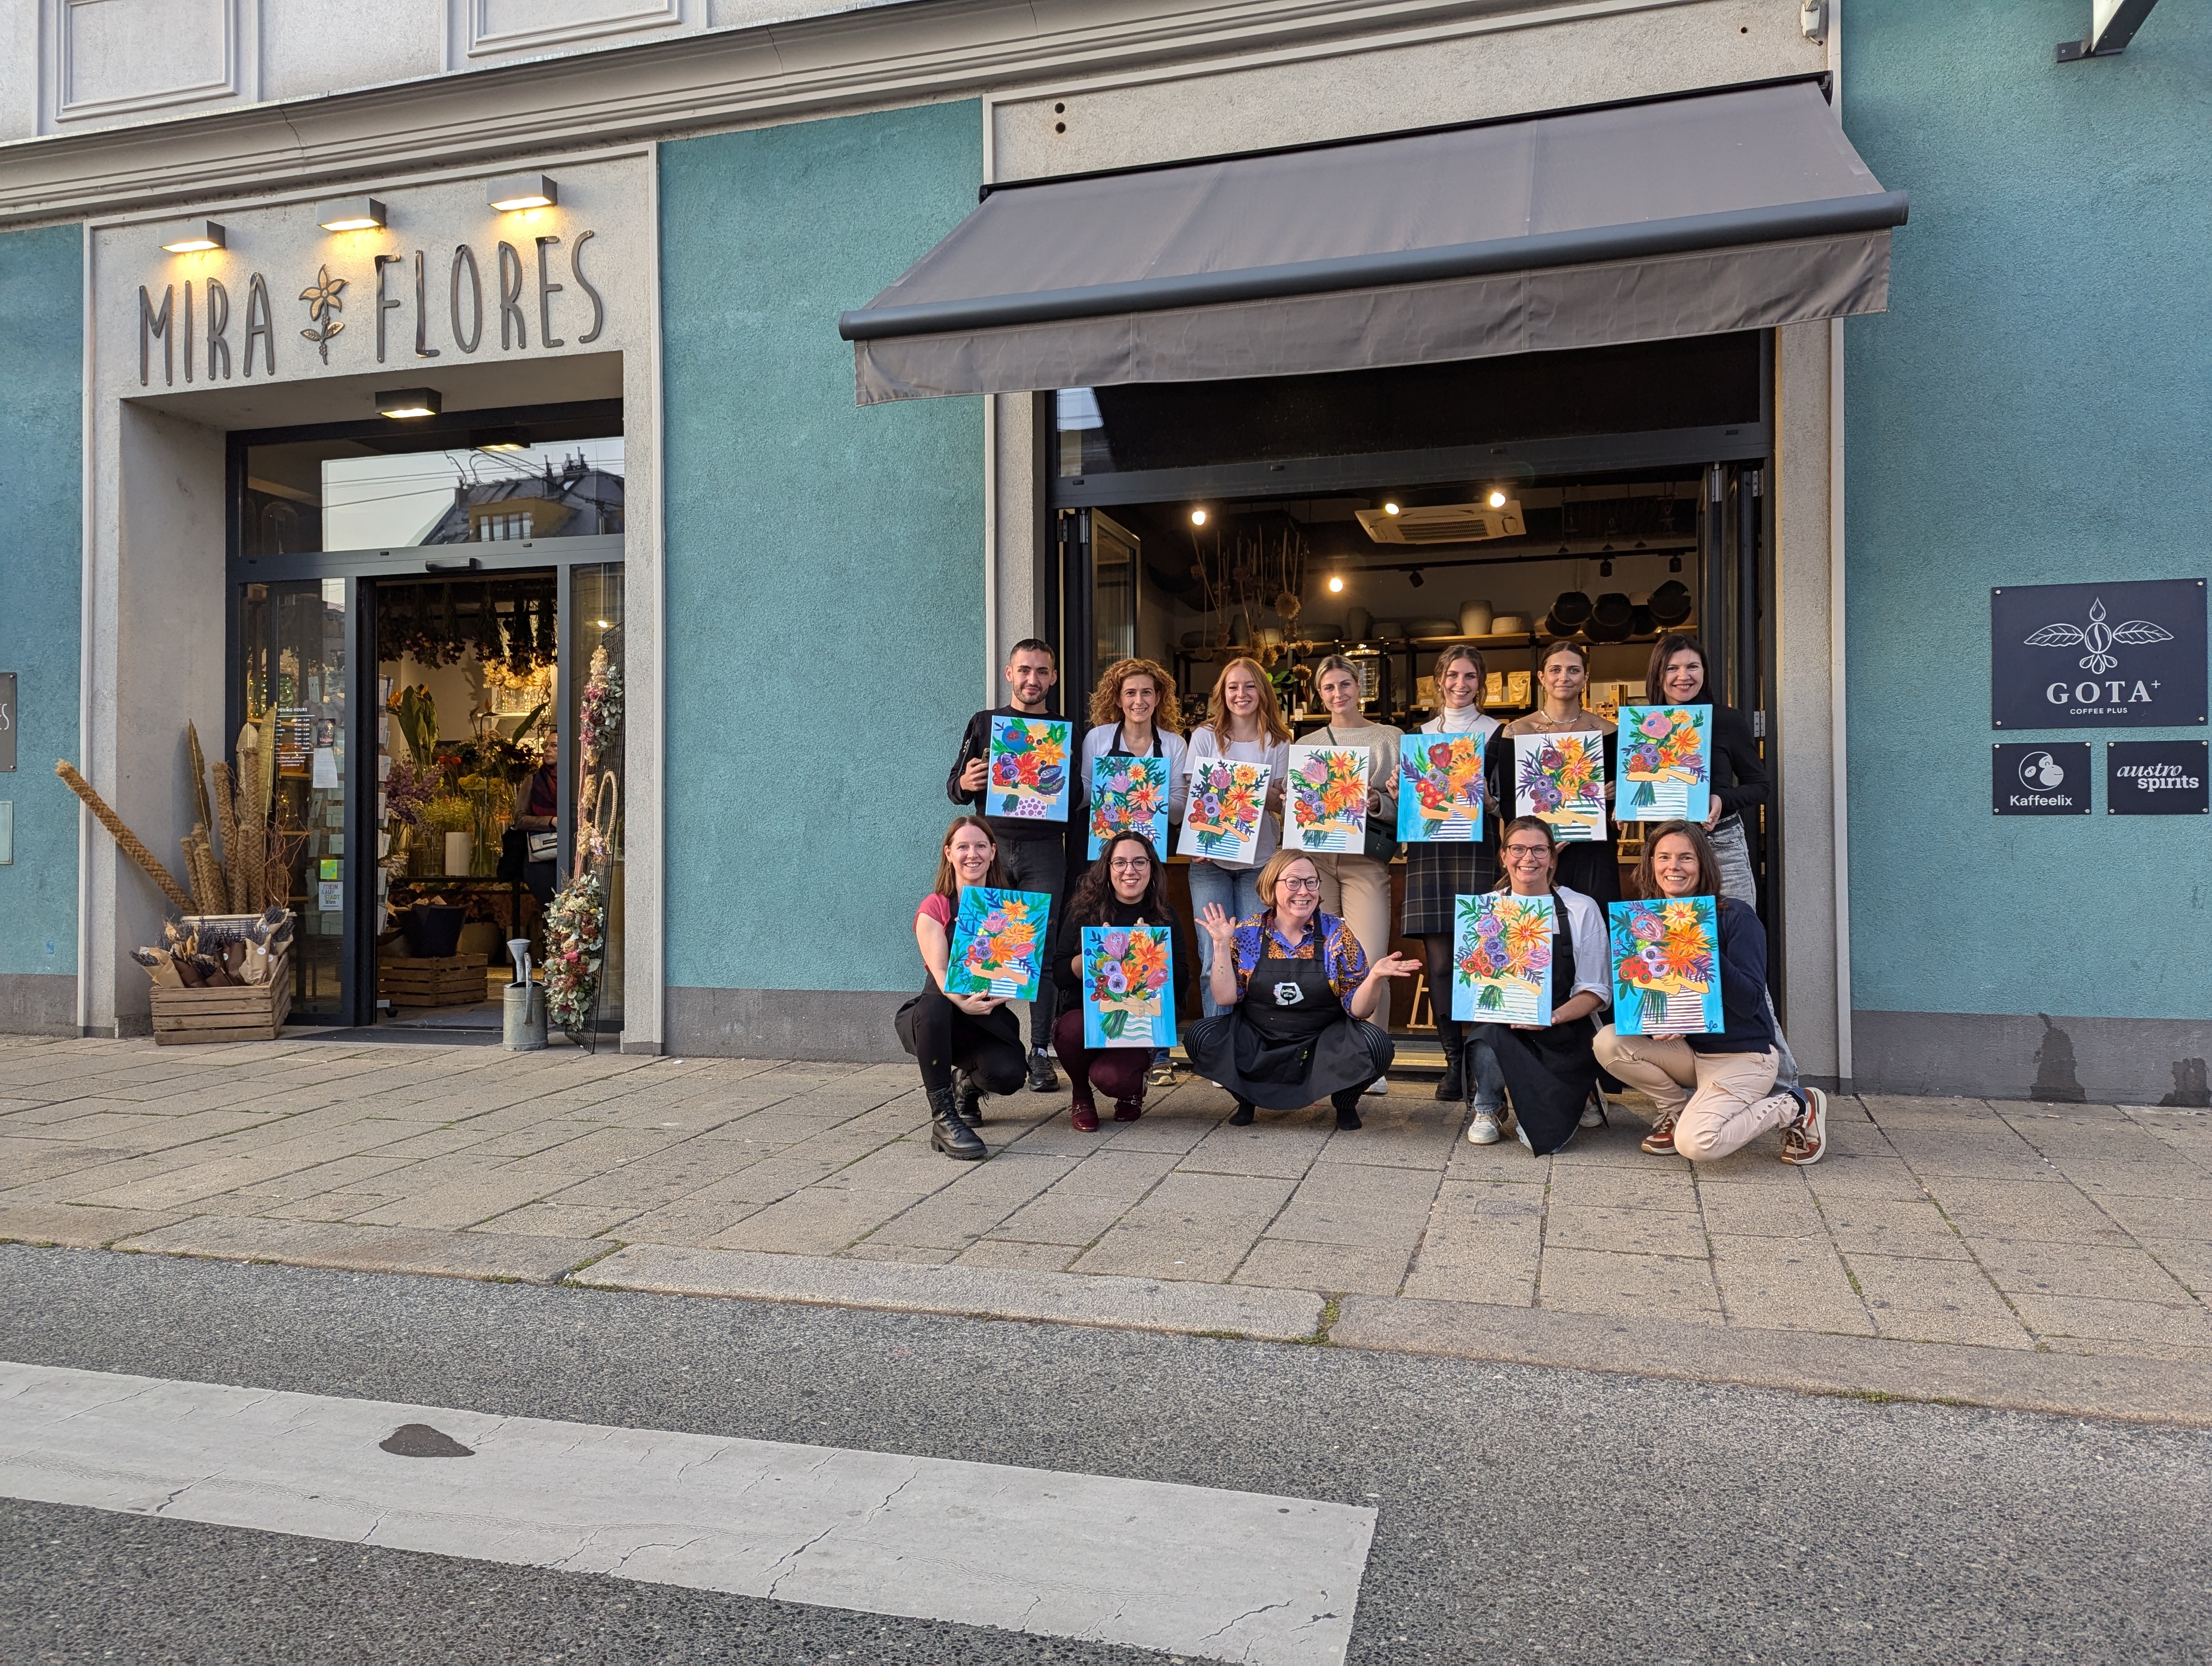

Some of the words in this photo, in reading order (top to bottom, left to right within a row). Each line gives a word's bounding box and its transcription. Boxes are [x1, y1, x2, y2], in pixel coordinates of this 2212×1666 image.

[139, 272, 275, 386] MIRA
[374, 230, 603, 363] FLORES
[0, 703, 10, 731] S
[2117, 762, 2183, 777] austro
[2137, 774, 2200, 792] spirits
[2009, 794, 2073, 806] Kaffeelix
